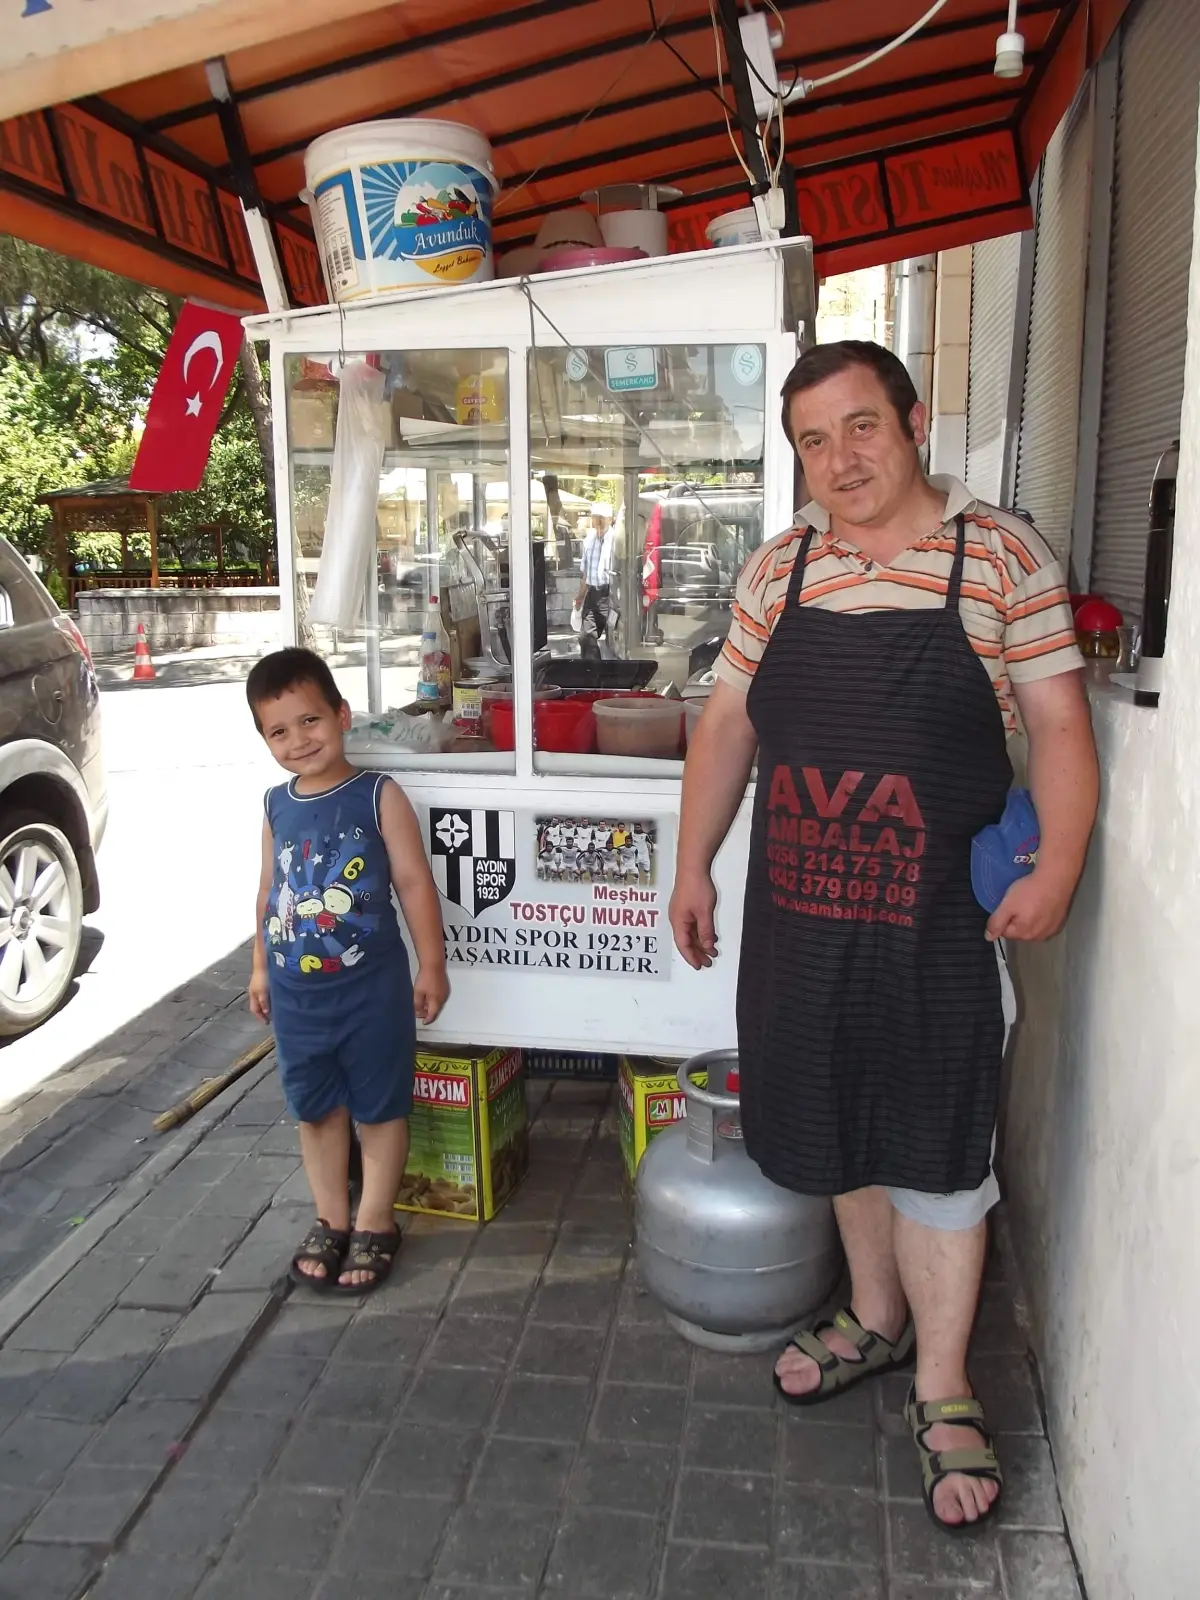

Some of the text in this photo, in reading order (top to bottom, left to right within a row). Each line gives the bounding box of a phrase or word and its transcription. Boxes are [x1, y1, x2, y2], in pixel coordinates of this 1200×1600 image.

[413, 219, 481, 255] Avunduk
[611, 377, 654, 387] SEMERKAND
[766, 765, 926, 828] AVA
[766, 814, 926, 858] AMBALAJ
[343, 856, 365, 880] 6
[476, 860, 507, 873] AYDIN
[804, 852, 845, 875] 214
[851, 855, 881, 877] 75
[892, 859, 921, 882] 78
[476, 873, 507, 887] SPOR
[477, 886, 499, 899] 1923
[801, 873, 841, 899] 379
[846, 880, 877, 901] 09
[885, 885, 917, 907] 09
[593, 885, 657, 904] Meşhur
[510, 902, 659, 928] TOSTÇU MURAT
[515, 928, 579, 949] SPOR
[444, 946, 659, 974] AŞARILAR DİLER.
